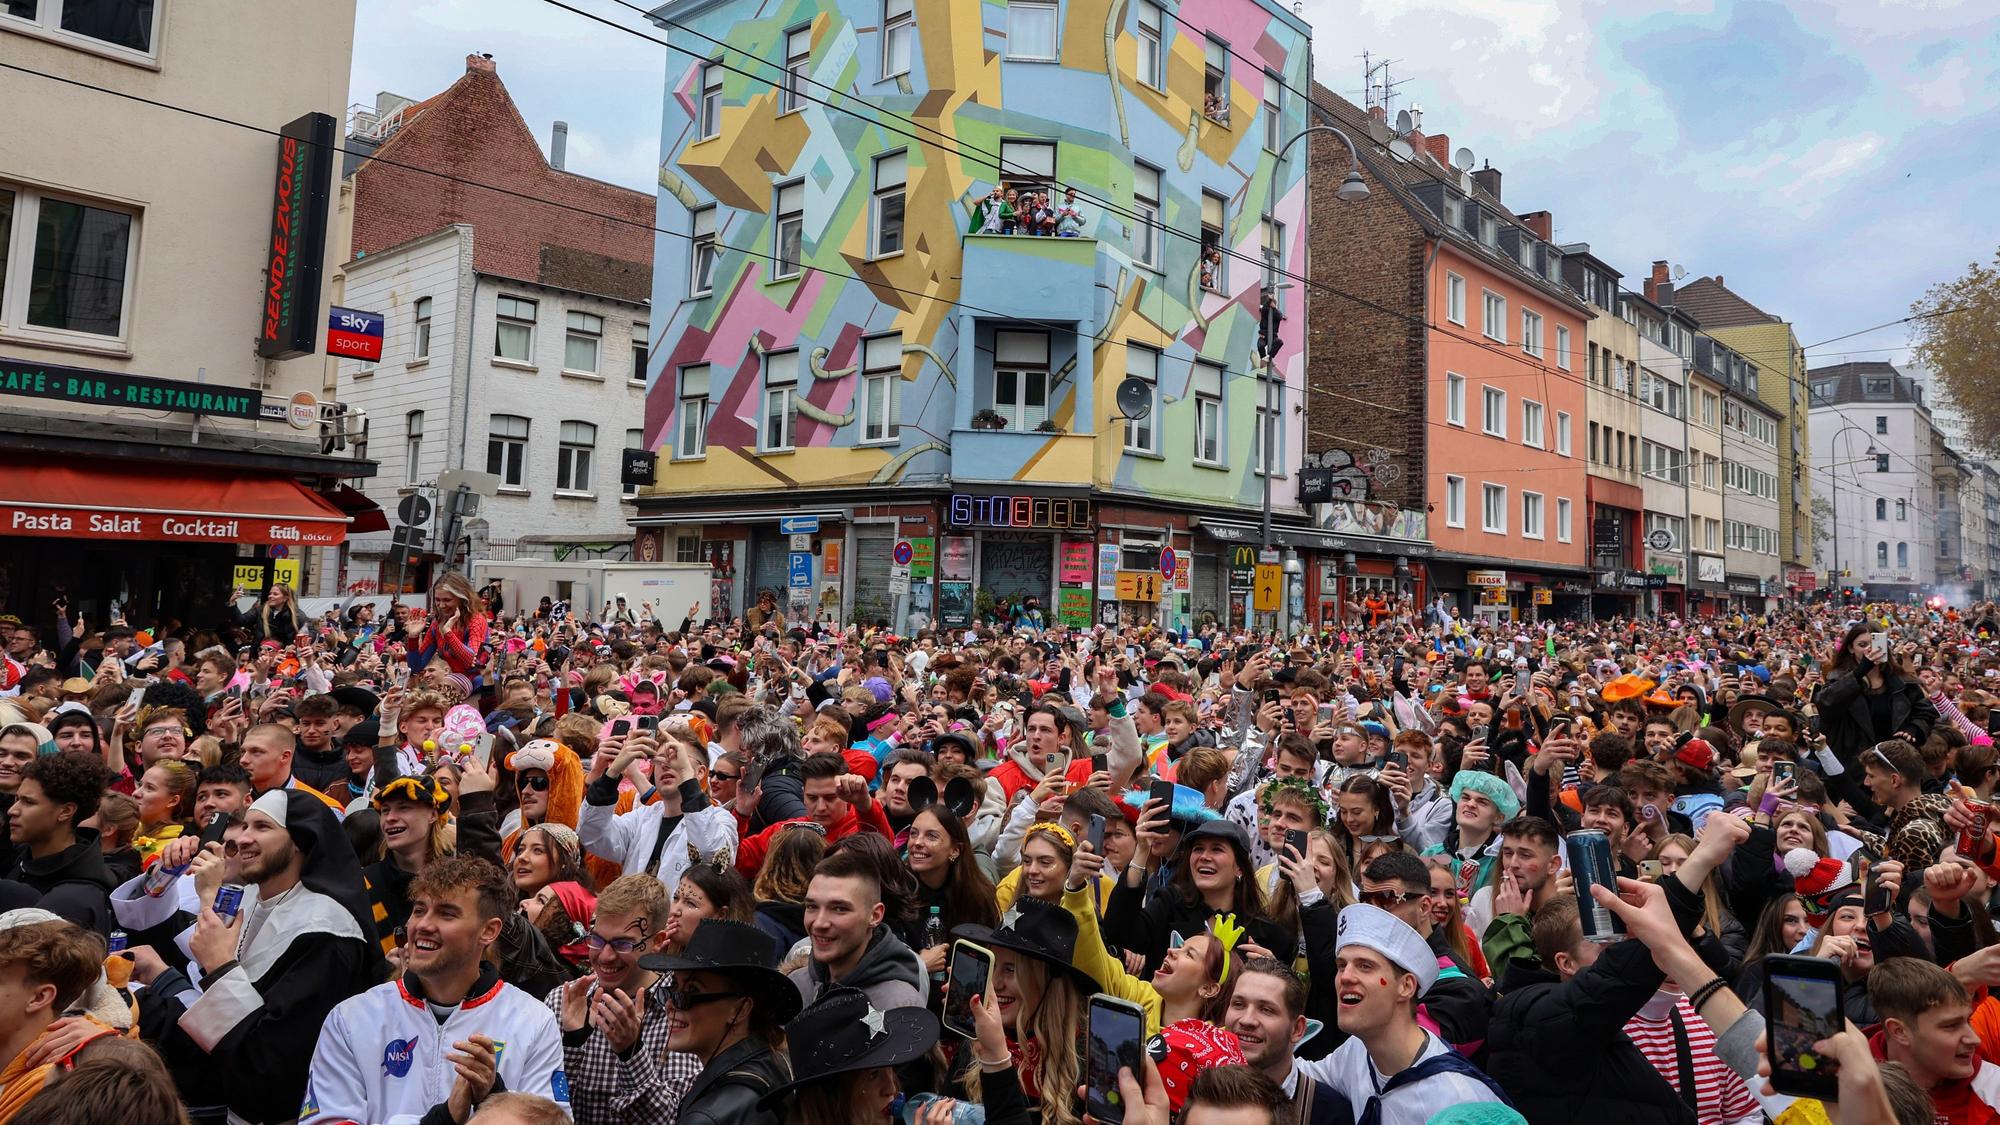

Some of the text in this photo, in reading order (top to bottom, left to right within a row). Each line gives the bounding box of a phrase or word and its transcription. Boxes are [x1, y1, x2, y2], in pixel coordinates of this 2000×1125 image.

[265, 136, 297, 341] RENDEZVOUS
[340, 314, 370, 333] sky
[336, 337, 370, 352] sport
[0, 371, 250, 414] AFÉ BAR RESTAURANT
[954, 498, 1087, 526] STIEFEL
[12, 511, 72, 531] Pasta
[89, 514, 141, 533] Salat
[162, 518, 239, 538] Cocktail
[268, 525, 300, 542] früh
[793, 555, 803, 569] P
[1262, 569, 1275, 580] U1
[1478, 576, 1501, 584] KIOSK
[655, 597, 661, 607] 3
[387, 1050, 410, 1062] NASA
